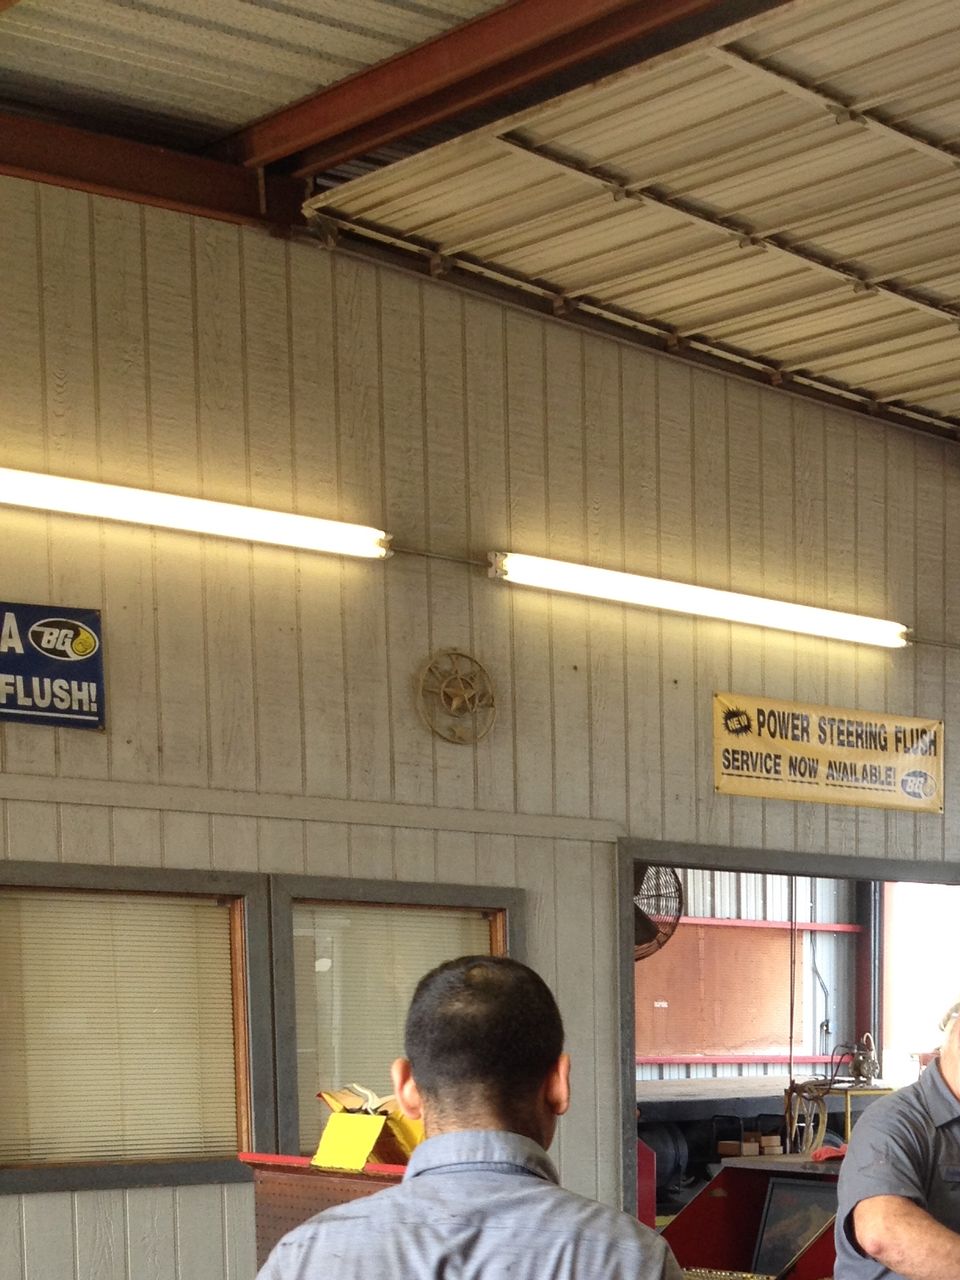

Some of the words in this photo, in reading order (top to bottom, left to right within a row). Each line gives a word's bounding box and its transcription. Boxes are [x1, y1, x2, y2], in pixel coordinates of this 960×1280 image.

[0, 612, 24, 654] A
[40, 627, 74, 651] BG
[0, 673, 98, 712] FLUSH!
[726, 713, 749, 732] NEW
[756, 708, 811, 743] POWER
[817, 715, 888, 753] STEERING
[894, 726, 937, 757] FLUSH
[721, 748, 782, 775] SERVICE
[788, 755, 819, 779] NOW
[825, 760, 896, 787] AVAILABLE!
